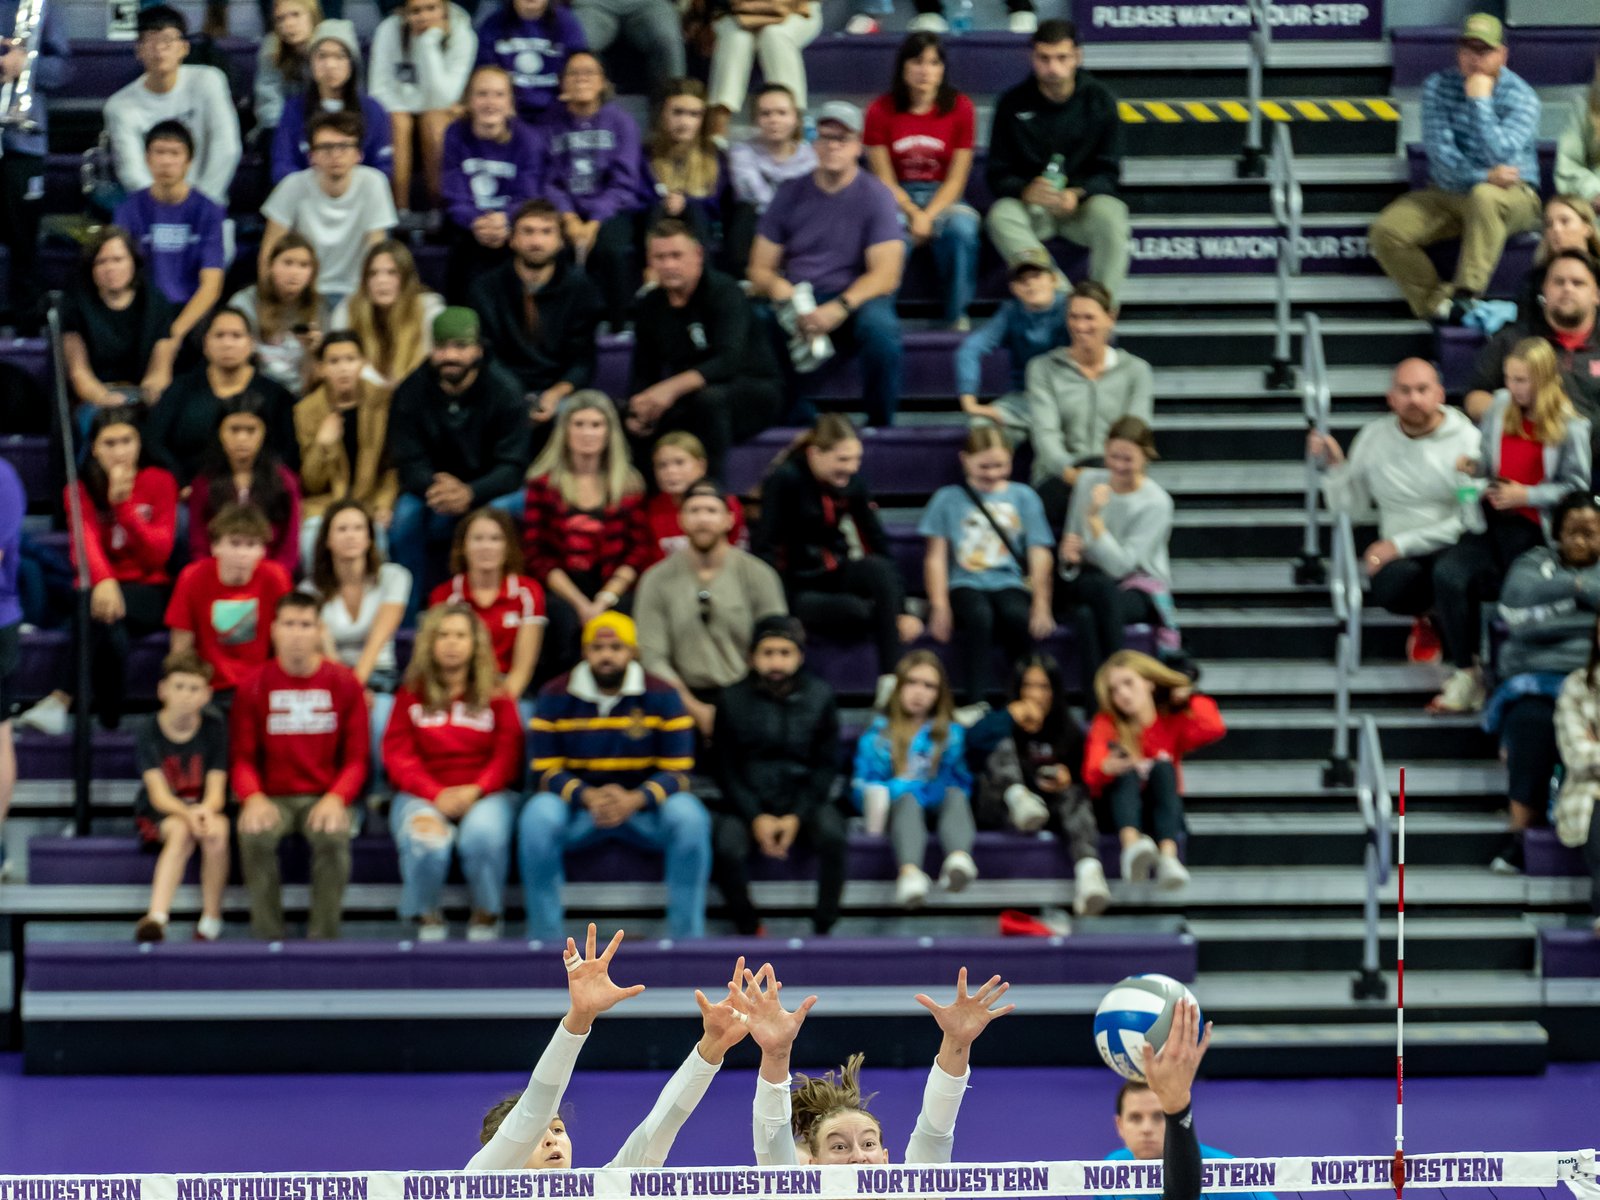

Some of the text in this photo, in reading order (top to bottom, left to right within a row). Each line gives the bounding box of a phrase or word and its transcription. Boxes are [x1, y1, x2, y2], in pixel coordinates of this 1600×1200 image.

[1252, 4, 1312, 26] OUR
[1313, 4, 1369, 26] STEP
[1128, 236, 1199, 259] LEASE
[403, 1173, 595, 1200] NORTHWESTERN
[630, 1170, 821, 1197] NORTHWESTERN
[857, 1167, 1049, 1194] NORTHWESTERN
[1084, 1163, 1276, 1190] NORTHSTERN
